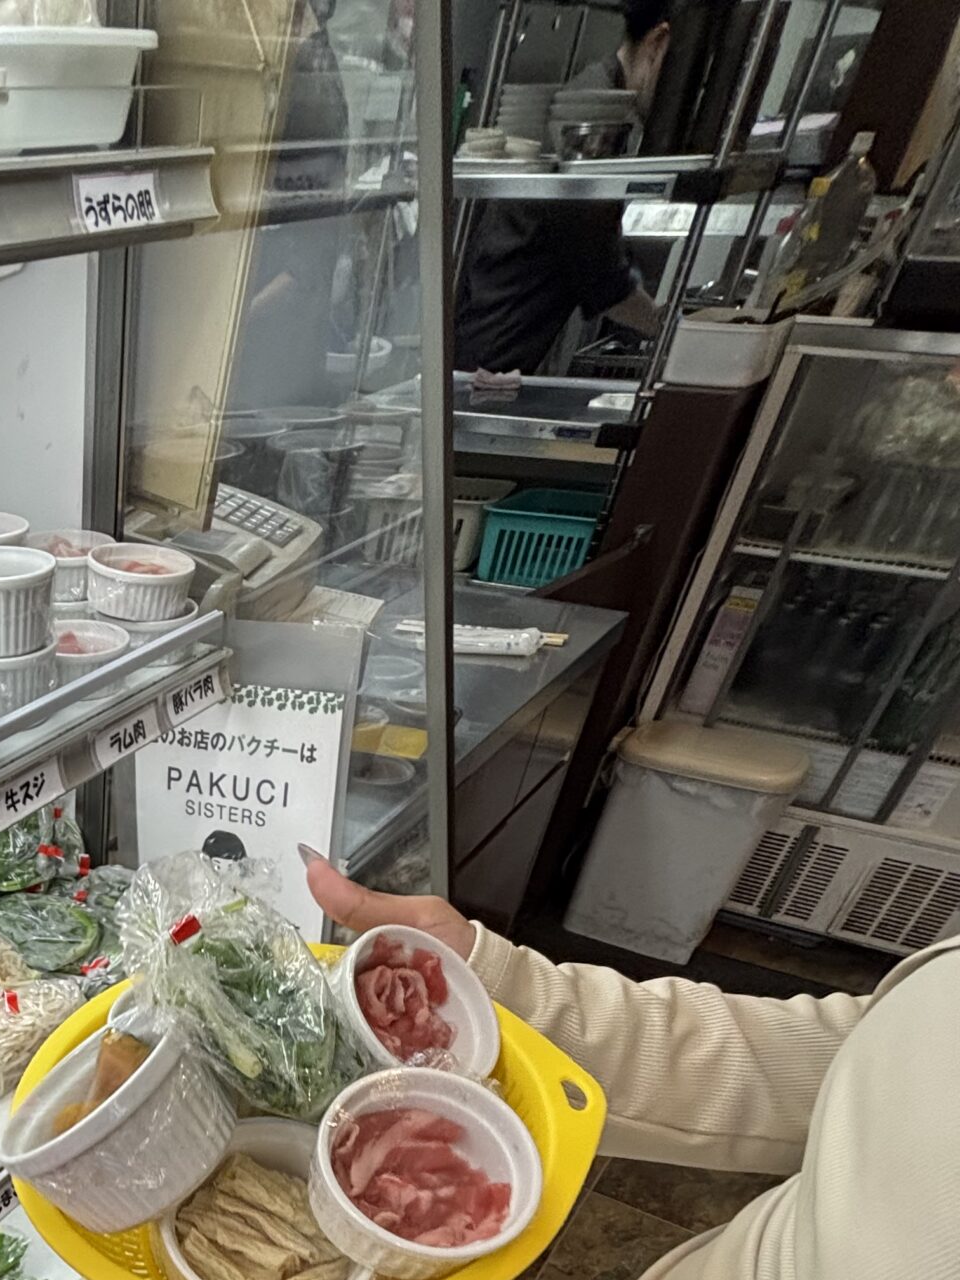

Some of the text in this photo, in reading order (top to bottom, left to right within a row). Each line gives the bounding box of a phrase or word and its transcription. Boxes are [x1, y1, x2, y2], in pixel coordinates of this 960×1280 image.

[109, 719, 147, 754] ラム肉
[151, 727, 317, 764] のお店のパクチーは
[4, 771, 46, 813] 牛スジ
[166, 765, 289, 808] PAKUCI
[184, 799, 267, 828] SISTERS
